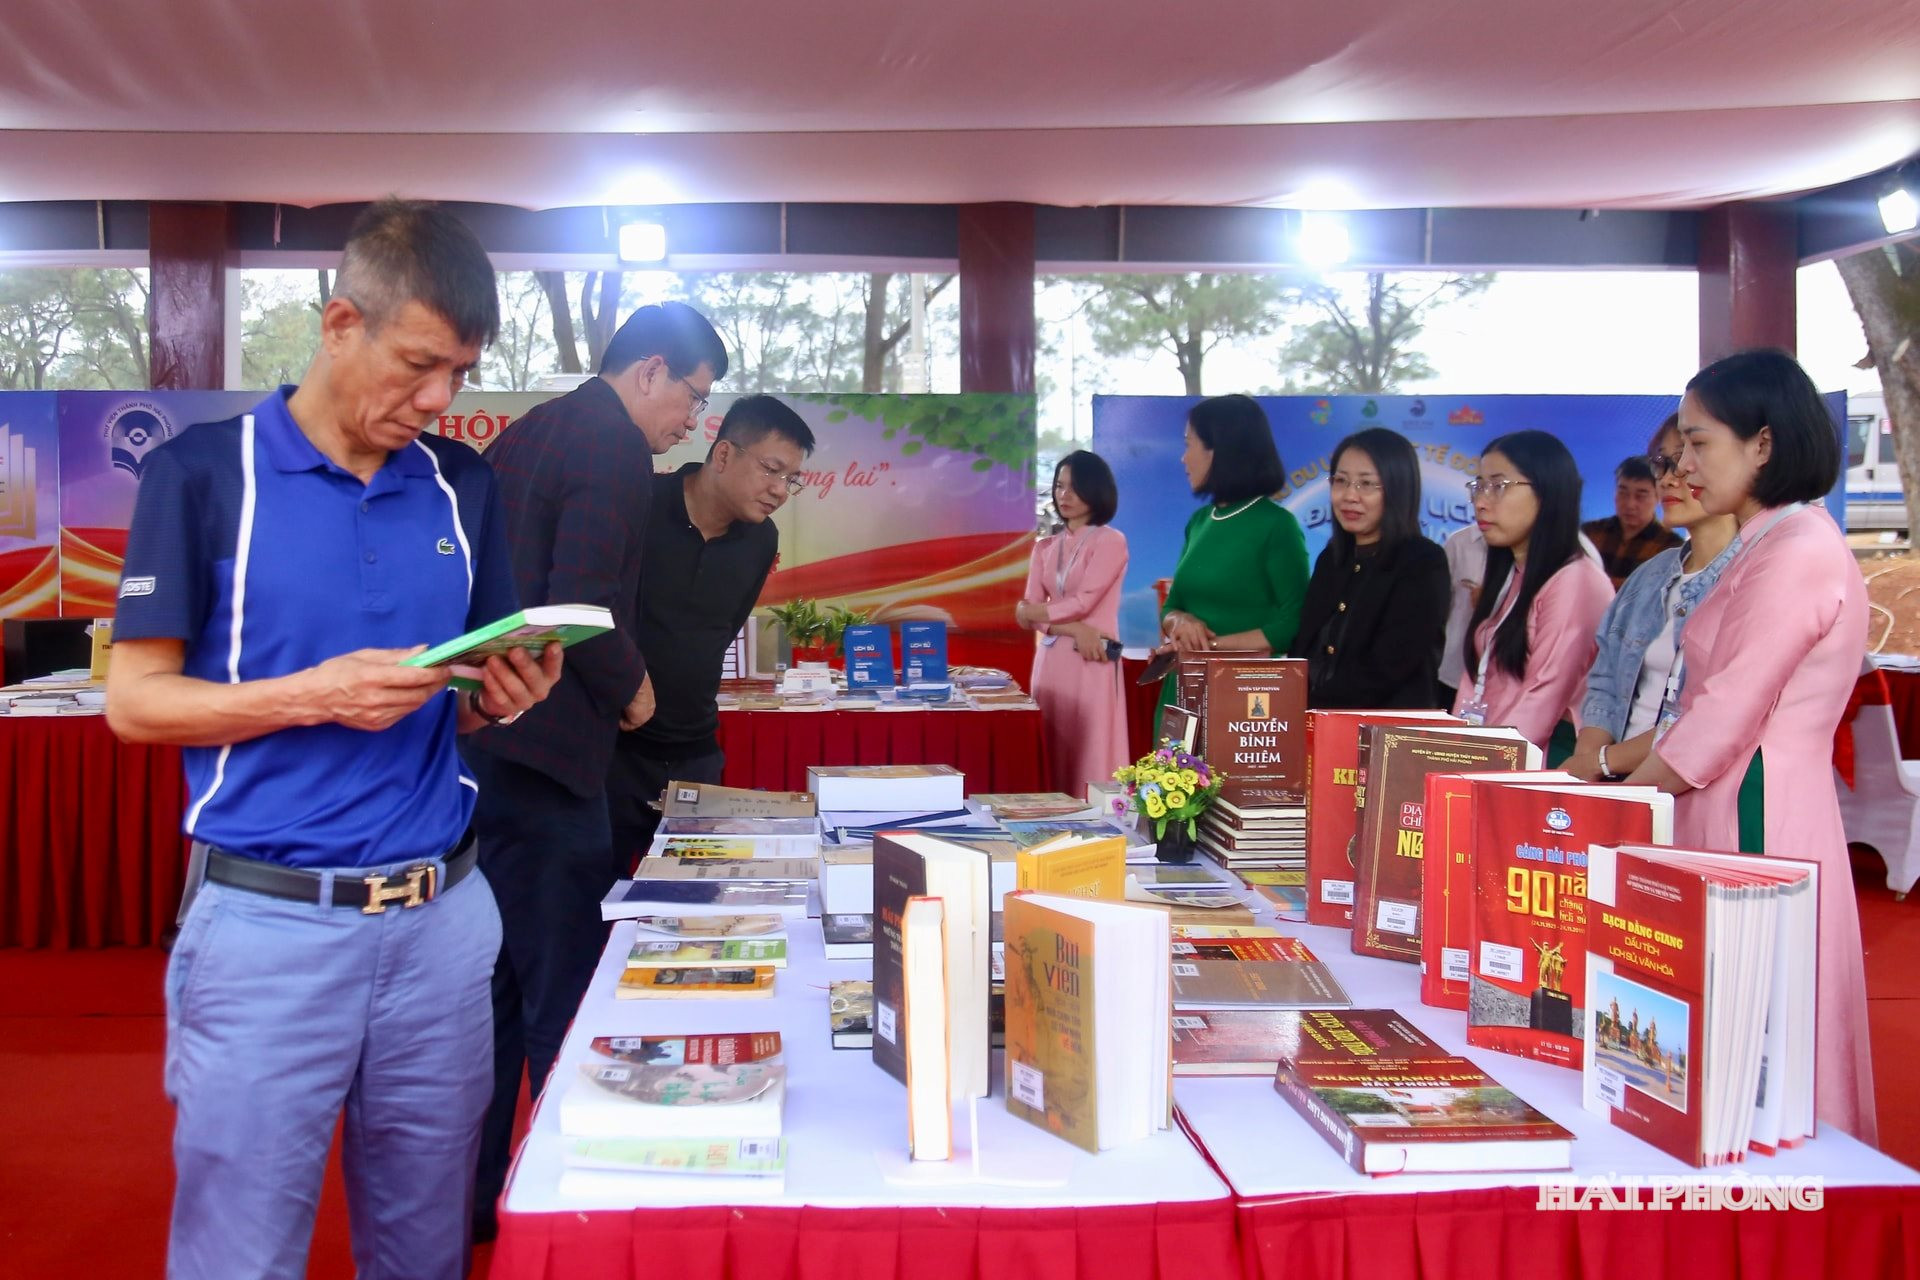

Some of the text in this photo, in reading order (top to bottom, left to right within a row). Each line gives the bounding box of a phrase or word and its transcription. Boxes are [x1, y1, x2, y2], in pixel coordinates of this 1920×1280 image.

[1228, 718, 1288, 733] NGUYỄN
[1240, 734, 1276, 747] BỈNH
[1234, 750, 1281, 763] KHIÊM
[1403, 804, 1422, 816] ĐỊA
[1402, 815, 1422, 826] CHÍ
[1516, 842, 1588, 867] CẢNG HẢI PHÒ
[1506, 866, 1587, 918] 90 nă
[1602, 912, 1626, 930] BẠCH
[1654, 930, 1683, 950] GIANG
[1625, 937, 1660, 956] DẤU TÍCH
[1313, 1074, 1372, 1082] THÀNH
[1374, 1074, 1435, 1082] HOÀNG
